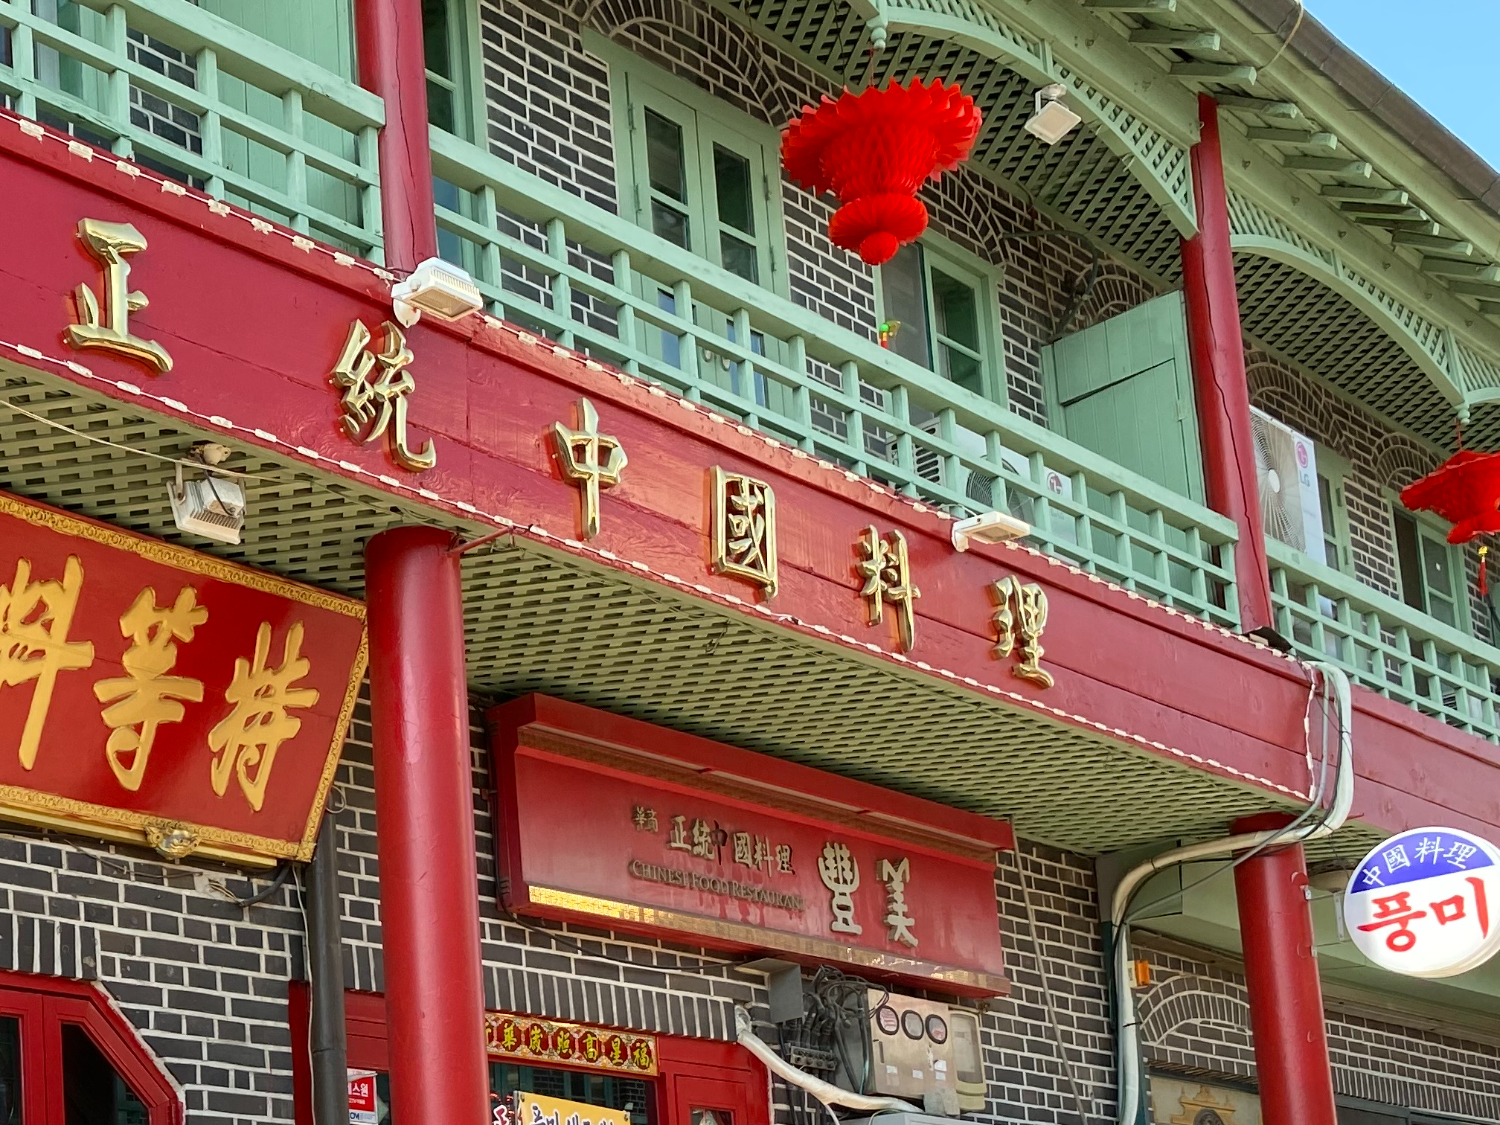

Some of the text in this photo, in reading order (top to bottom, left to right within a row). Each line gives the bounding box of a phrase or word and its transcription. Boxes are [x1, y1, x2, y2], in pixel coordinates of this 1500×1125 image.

[1361, 836, 1477, 888] 中國料理
[1357, 877, 1490, 952] 풍미
